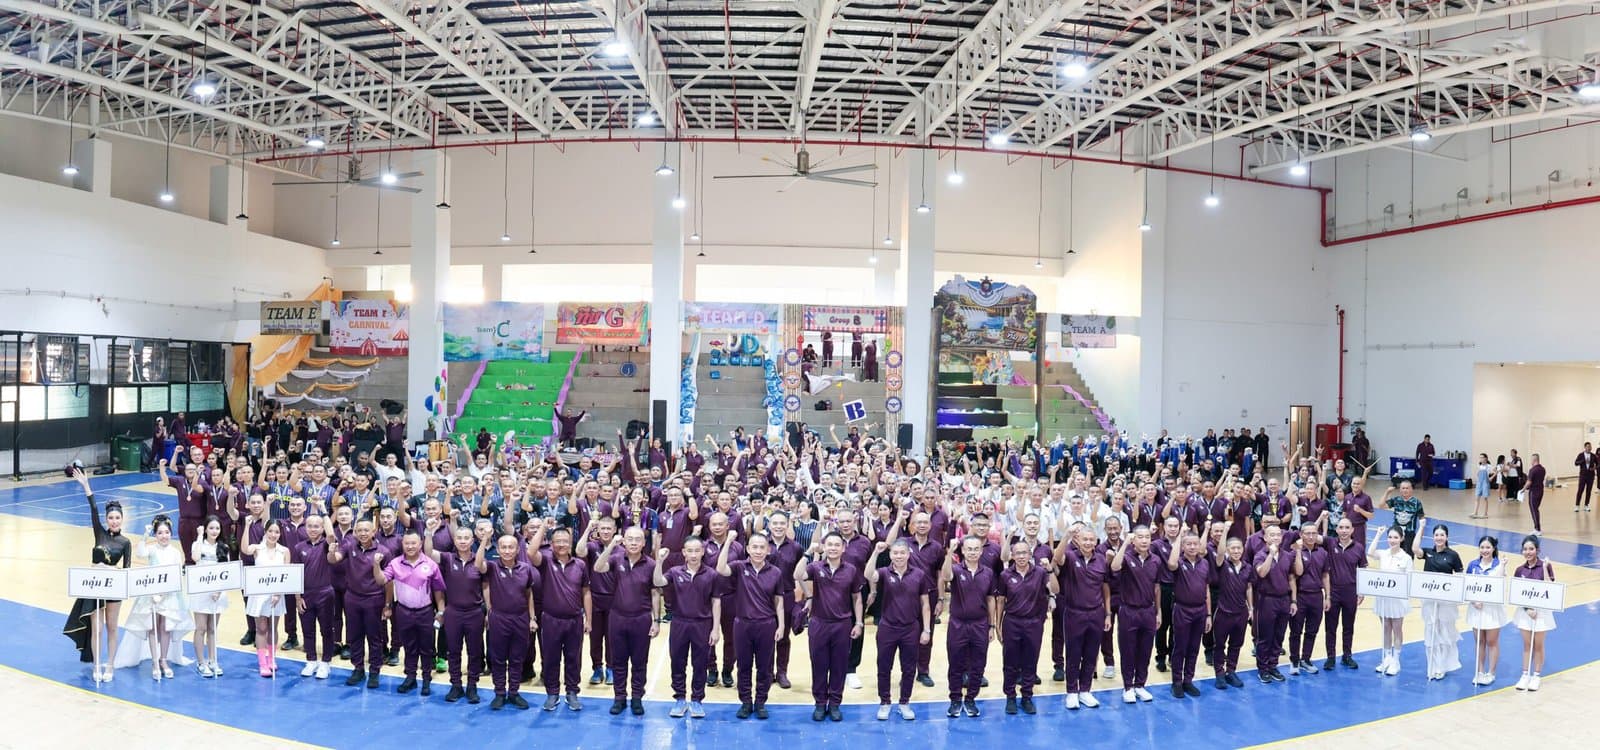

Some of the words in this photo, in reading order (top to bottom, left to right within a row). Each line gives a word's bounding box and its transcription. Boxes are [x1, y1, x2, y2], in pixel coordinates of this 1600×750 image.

[267, 308, 304, 319] TEAM
[308, 308, 316, 319] E
[353, 308, 378, 318] TEAM
[605, 307, 625, 328] G
[703, 310, 746, 324] TEAM
[754, 311, 764, 325] D
[348, 320, 391, 330] CARNIVAL
[829, 316, 850, 325] Group
[853, 315, 861, 325] B
[1071, 326, 1096, 334] TEAM
[845, 401, 866, 421] B
[82, 576, 101, 589] กลุ่ม
[104, 578, 113, 587] E
[136, 575, 155, 587] กลุ่ม
[158, 574, 167, 583] H
[199, 571, 217, 584] กลุ่ม
[219, 571, 228, 580] G
[258, 573, 277, 586] กลุ่ม
[280, 574, 288, 583] F
[1368, 577, 1385, 589] กลุ่ม
[1387, 579, 1396, 588] D
[1422, 579, 1440, 591] กลุ่ม
[1442, 583, 1451, 591] C
[1466, 582, 1482, 593] กลุ่ม
[1485, 584, 1492, 593] B
[1521, 587, 1539, 599] กลุ่ม
[1541, 590, 1549, 599] A
